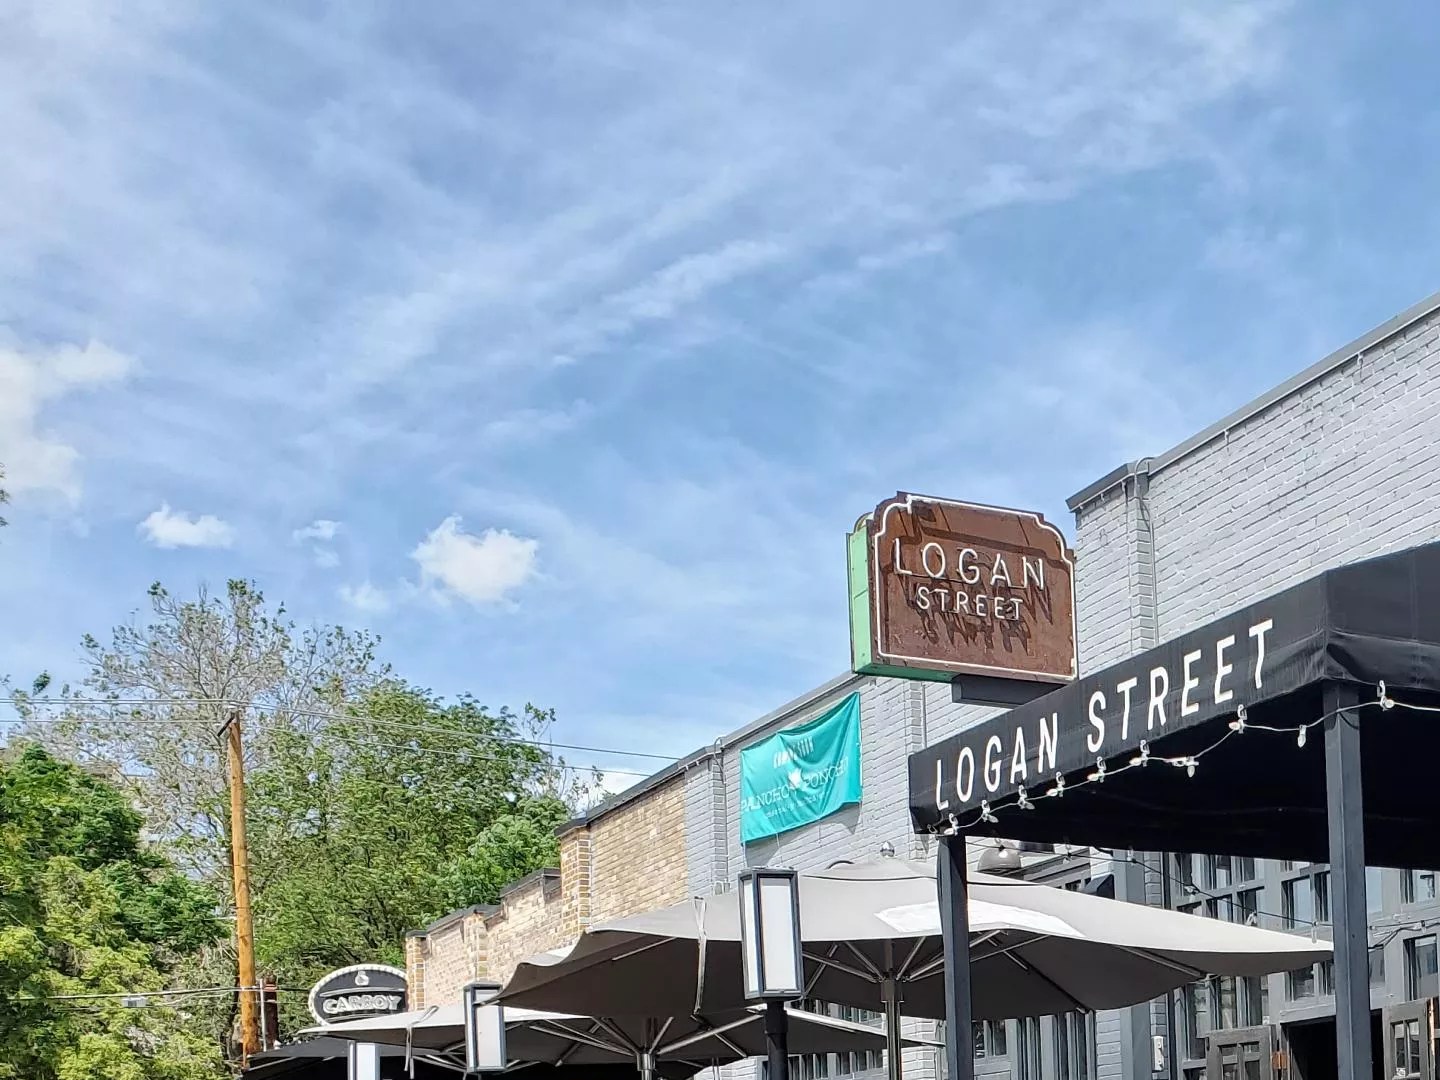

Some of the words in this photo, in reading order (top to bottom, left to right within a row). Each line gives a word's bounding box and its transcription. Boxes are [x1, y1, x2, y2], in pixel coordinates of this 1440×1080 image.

[893, 537, 1045, 591] LOGAN
[916, 586, 1024, 621] STREET
[936, 712, 1058, 811] LOGAN
[1087, 618, 1273, 753] STREET
[323, 994, 402, 1014] CARBOY
